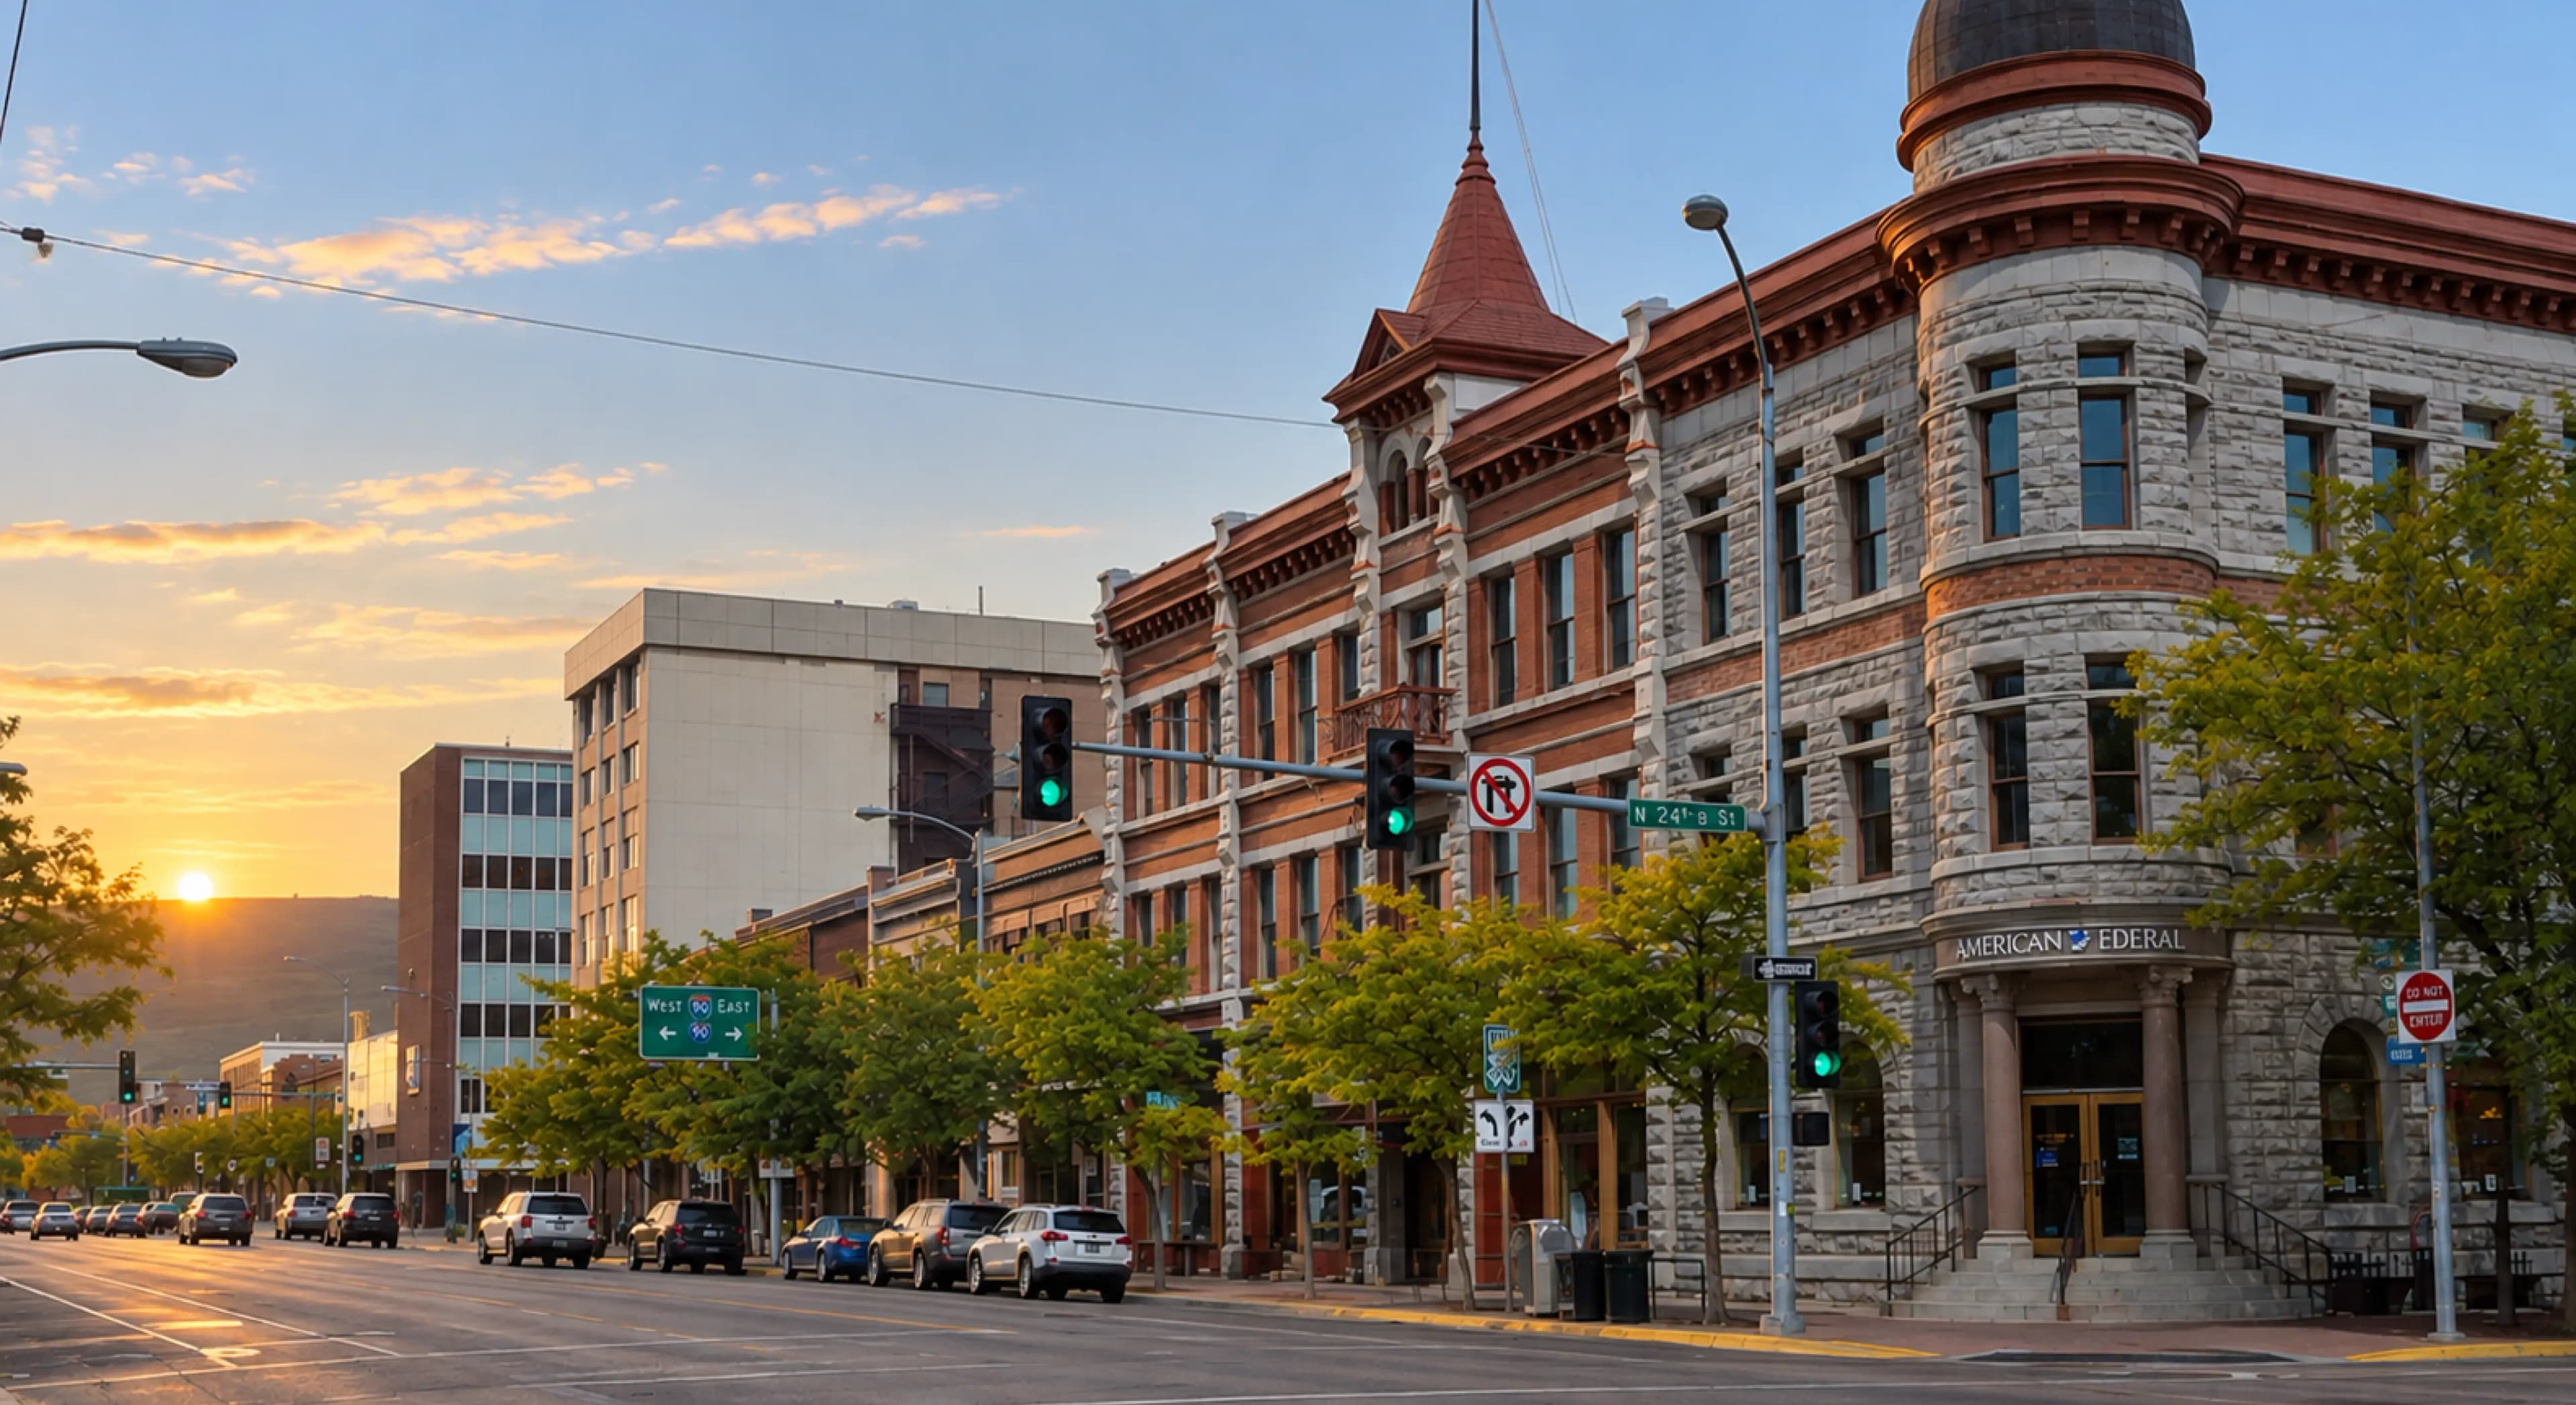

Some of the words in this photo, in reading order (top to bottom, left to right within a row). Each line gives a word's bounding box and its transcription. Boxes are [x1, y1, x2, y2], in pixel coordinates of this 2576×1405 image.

[1635, 806, 1646, 823] N
[1718, 809, 1735, 825] St
[1956, 930, 2061, 961] AMERICAN
[2406, 987, 2420, 999] DO
[2423, 986, 2443, 997] NOT
[648, 998, 682, 1012] West
